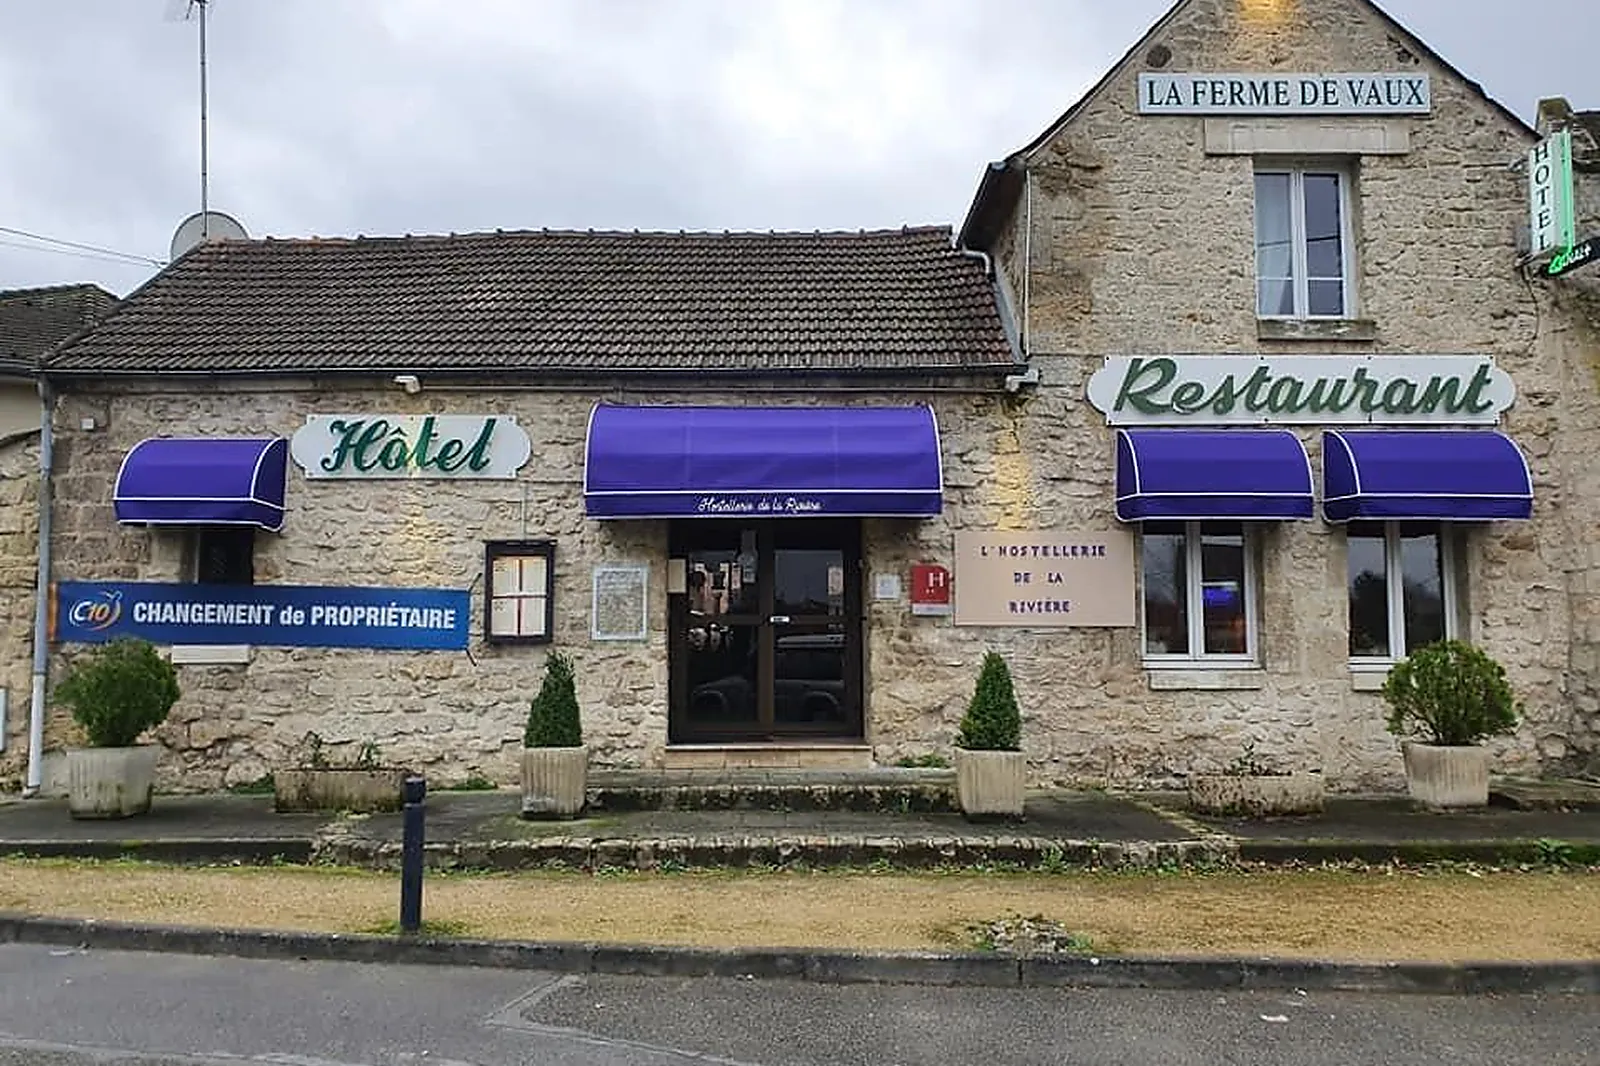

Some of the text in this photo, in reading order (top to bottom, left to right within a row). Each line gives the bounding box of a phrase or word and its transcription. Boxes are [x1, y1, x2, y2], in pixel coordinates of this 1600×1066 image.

[1146, 79, 1425, 106] LA FERME DE VAUX
[1532, 141, 1551, 251] HOTEL
[1114, 358, 1493, 415] Restaurant
[320, 416, 498, 472] Hôtel
[758, 497, 770, 511] de
[773, 497, 783, 511] la
[928, 572, 945, 588] H
[1013, 572, 1063, 584] DE LA
[133, 601, 456, 629] CHANGEMENT de PROPRIÉTAIRE
